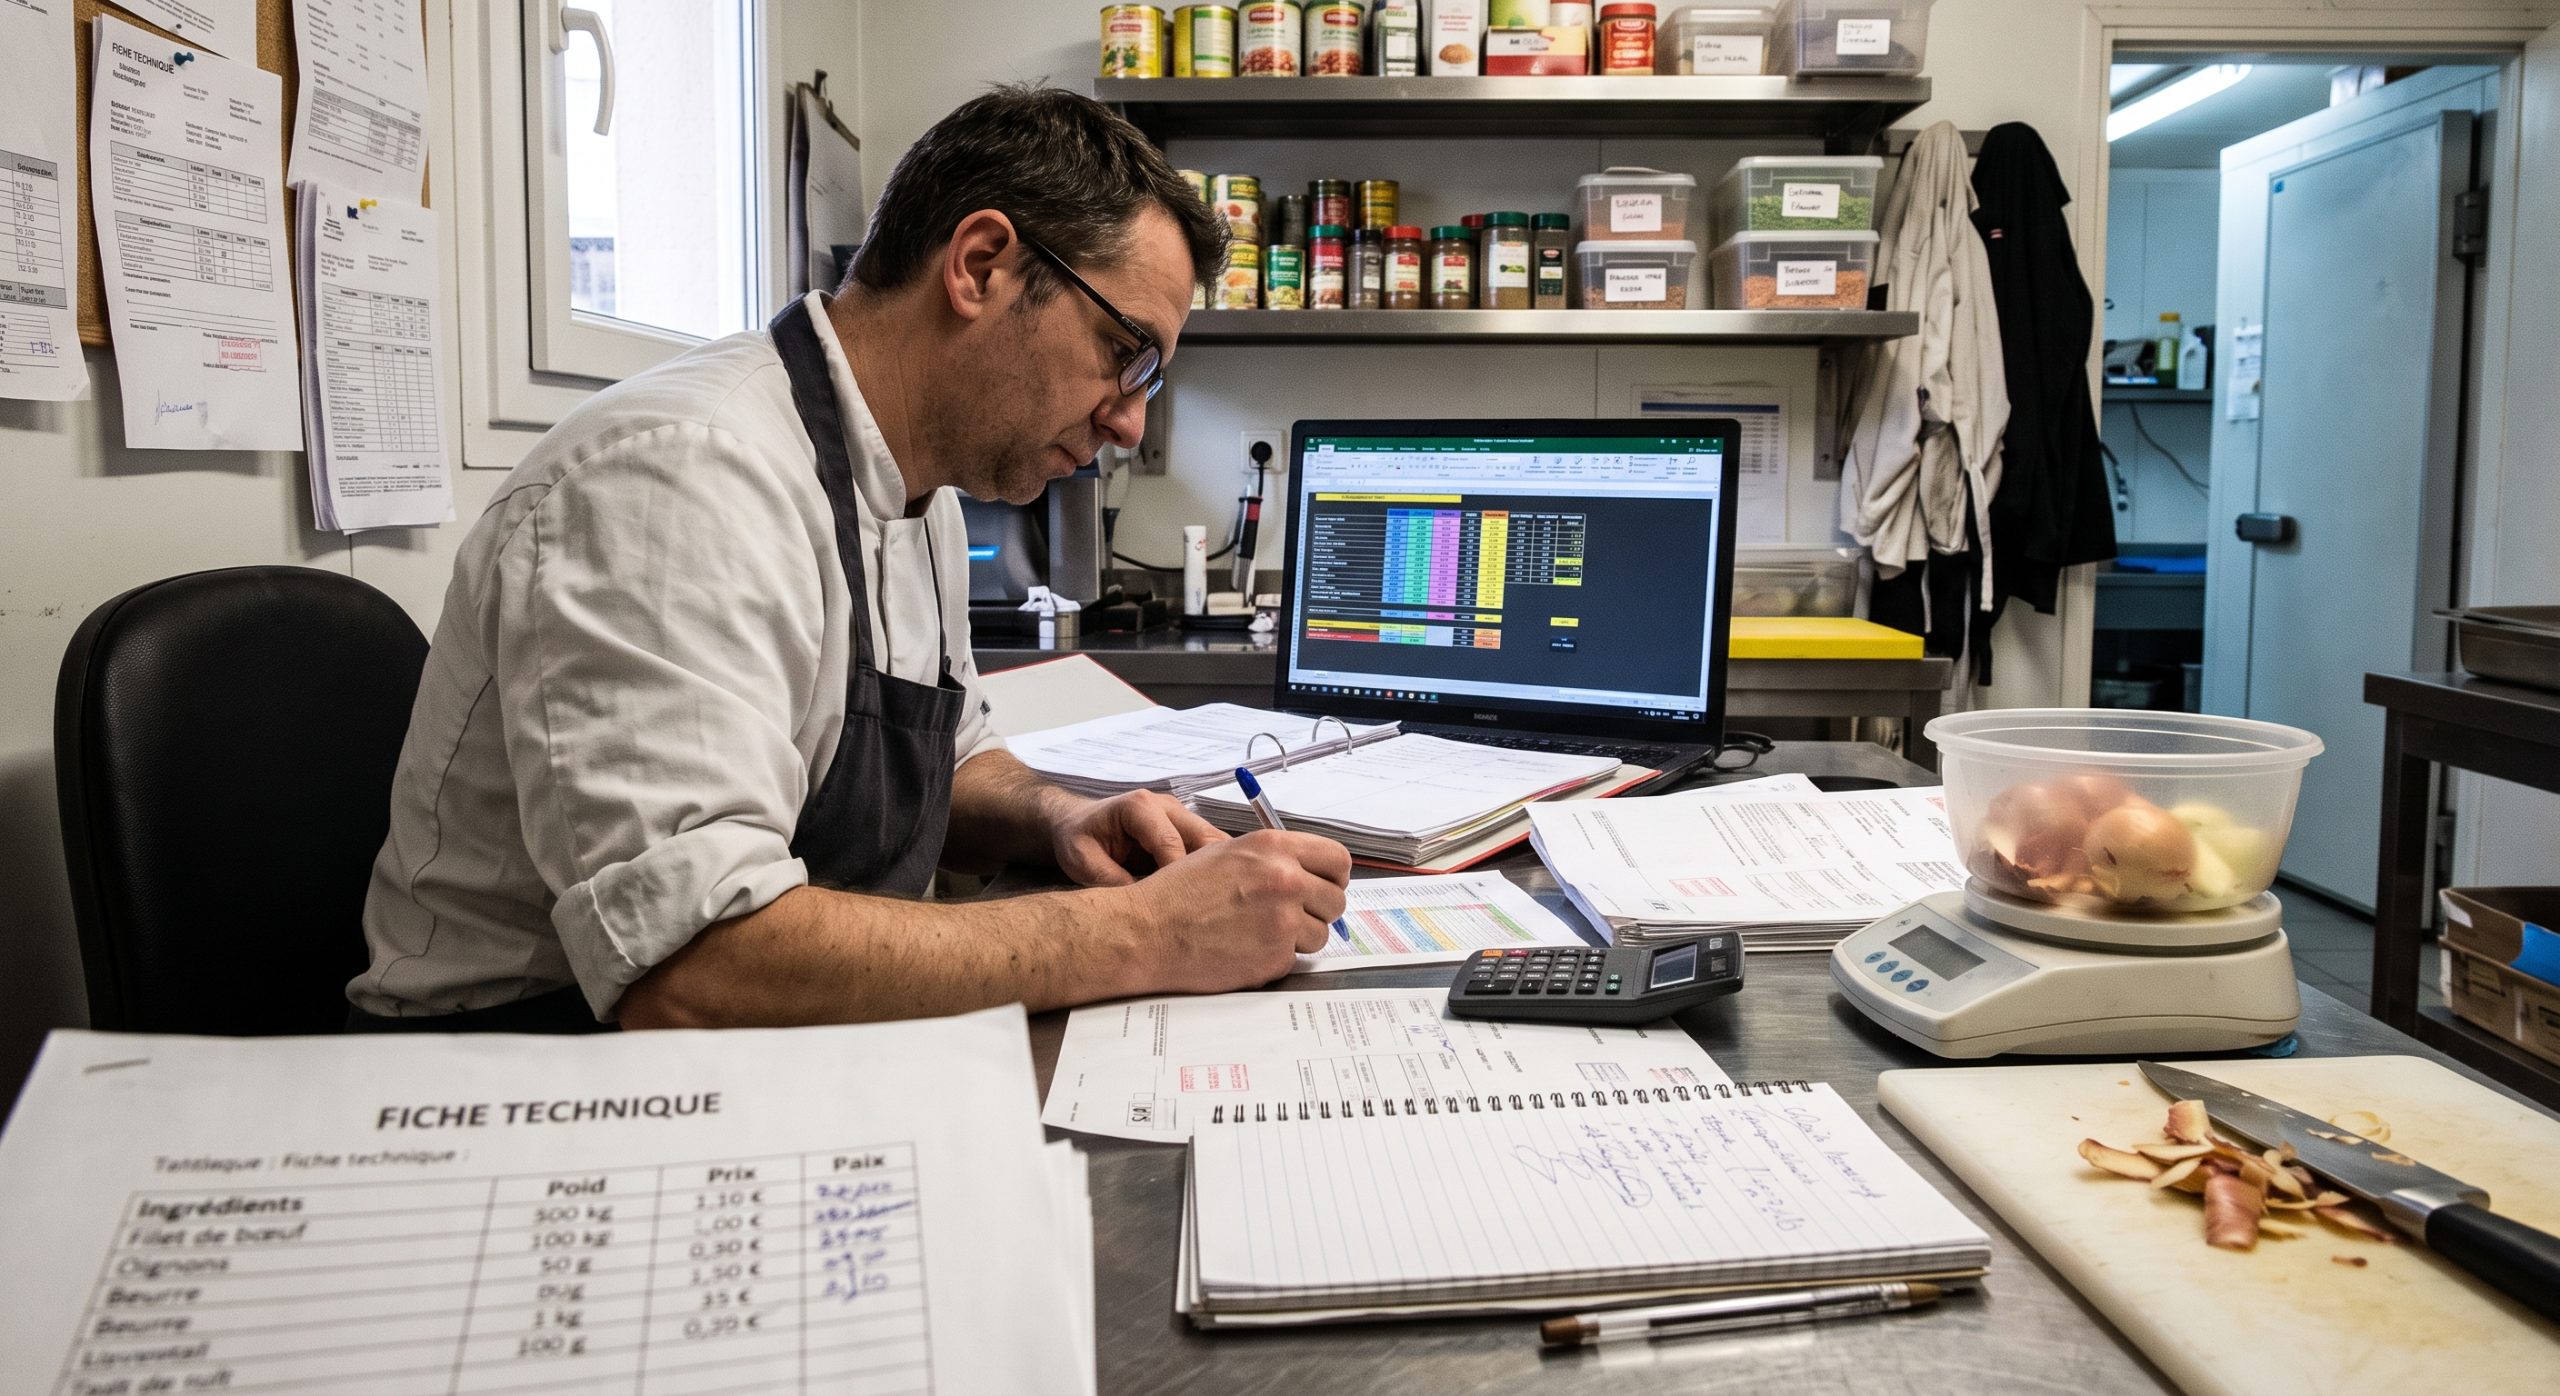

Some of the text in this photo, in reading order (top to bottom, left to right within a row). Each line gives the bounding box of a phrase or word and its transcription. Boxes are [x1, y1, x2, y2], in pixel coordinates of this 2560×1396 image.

[377, 1092, 722, 1130] FICHE TECHNIQUE
[348, 1147, 456, 1170] technique
[833, 1153, 886, 1173] Paix
[546, 1176, 608, 1198] Poid
[707, 1166, 757, 1185] Prix
[137, 1196, 304, 1222] Ingrédients
[105, 1284, 202, 1308] Beurre
